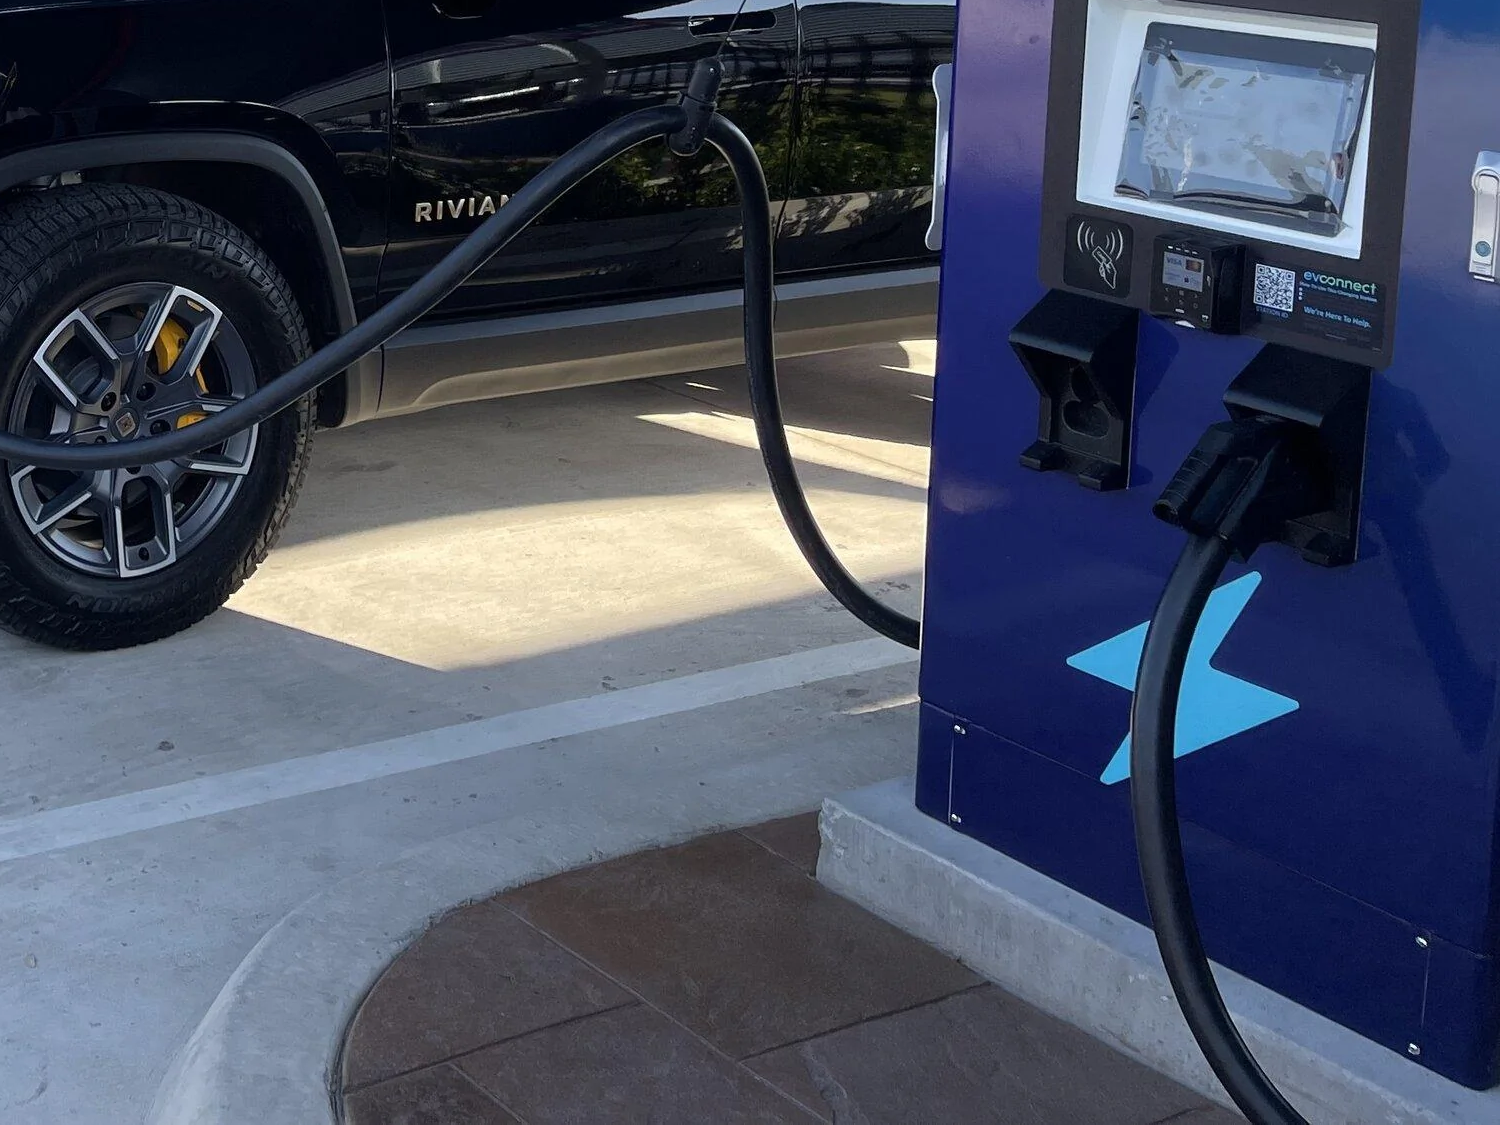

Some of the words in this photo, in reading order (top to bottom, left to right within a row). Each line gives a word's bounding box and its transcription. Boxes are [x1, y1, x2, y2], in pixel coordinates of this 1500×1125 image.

[1166, 257, 1182, 265] VISA
[1303, 271, 1377, 295] evconnect
[1303, 306, 1325, 318] We're
[1325, 311, 1342, 322] Here
[1343, 315, 1352, 323] To
